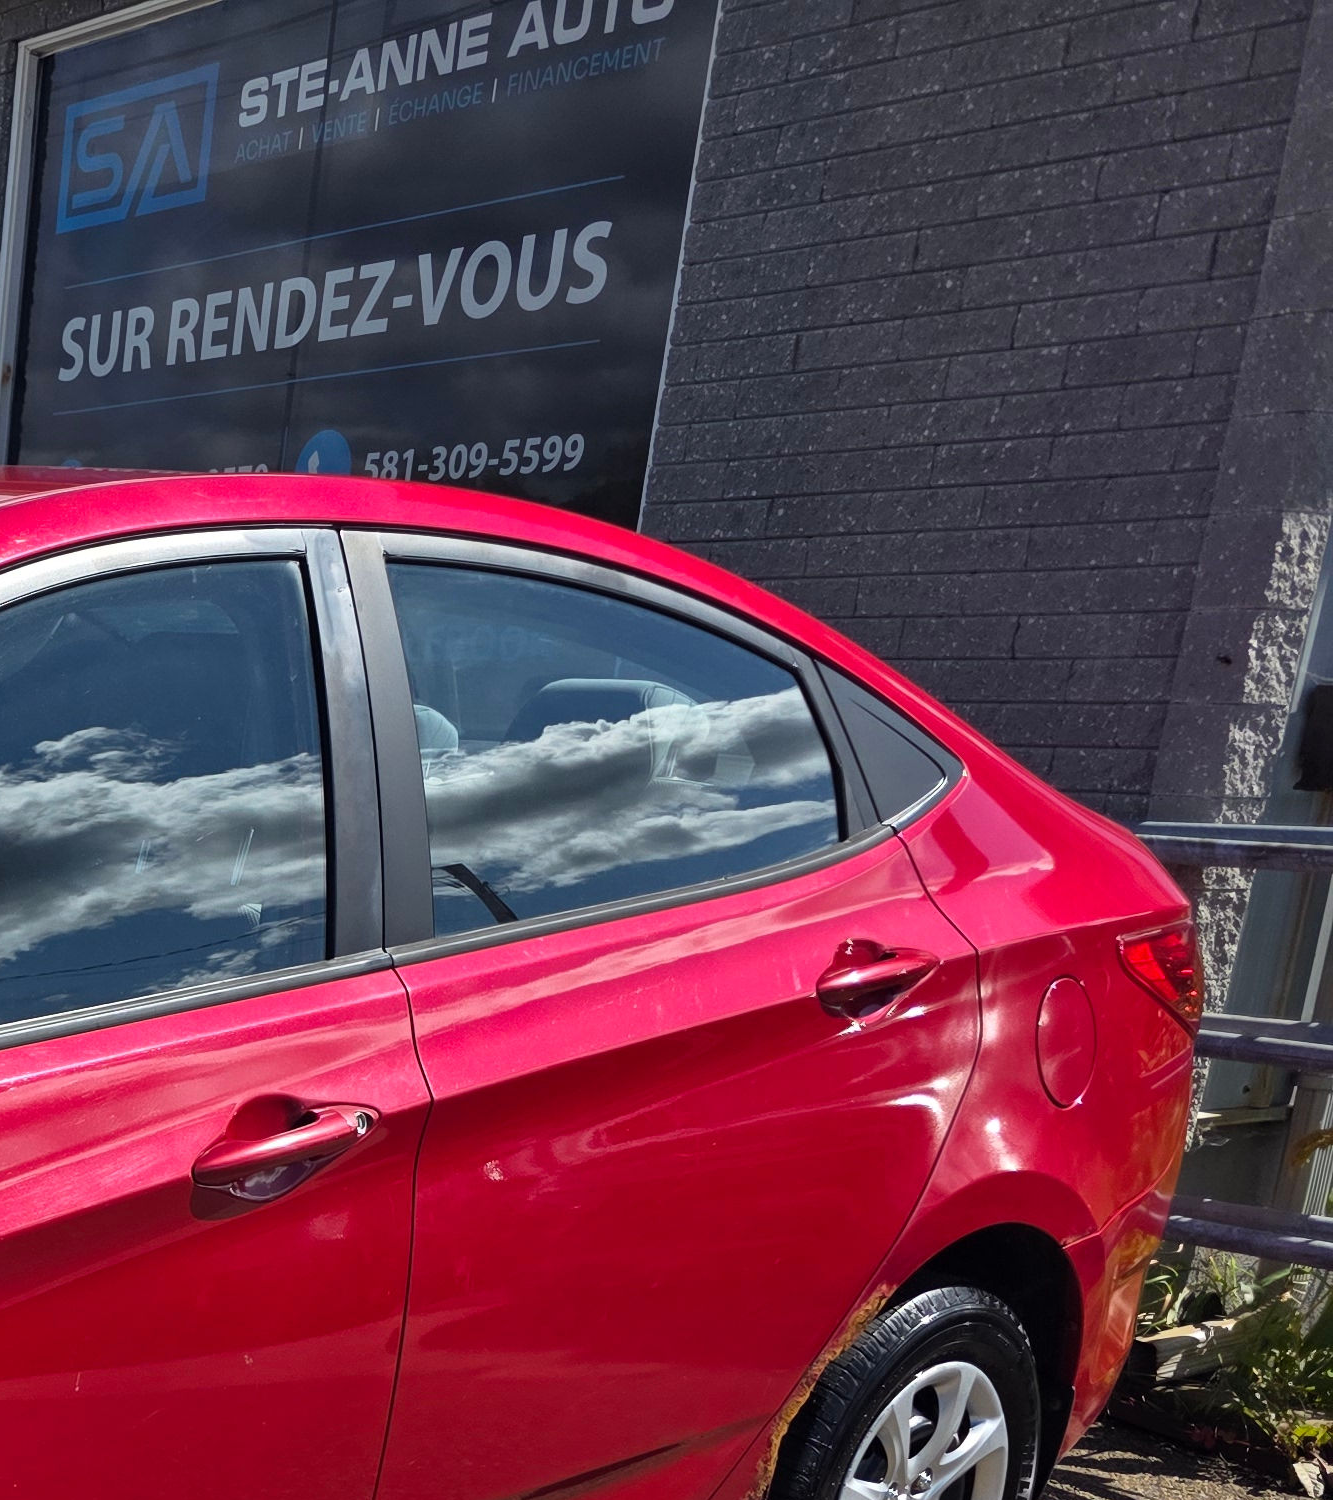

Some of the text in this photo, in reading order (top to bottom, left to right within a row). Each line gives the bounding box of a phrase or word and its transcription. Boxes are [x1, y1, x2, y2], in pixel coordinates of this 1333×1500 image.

[234, 36, 667, 164] ACHAT VENTE ÉCHANGE FINANCEMENT
[238, 12, 493, 128] STE-ANNE
[58, 221, 613, 382] SUR RENDEZ-VOUS
[364, 433, 585, 482] 581-309-5599
